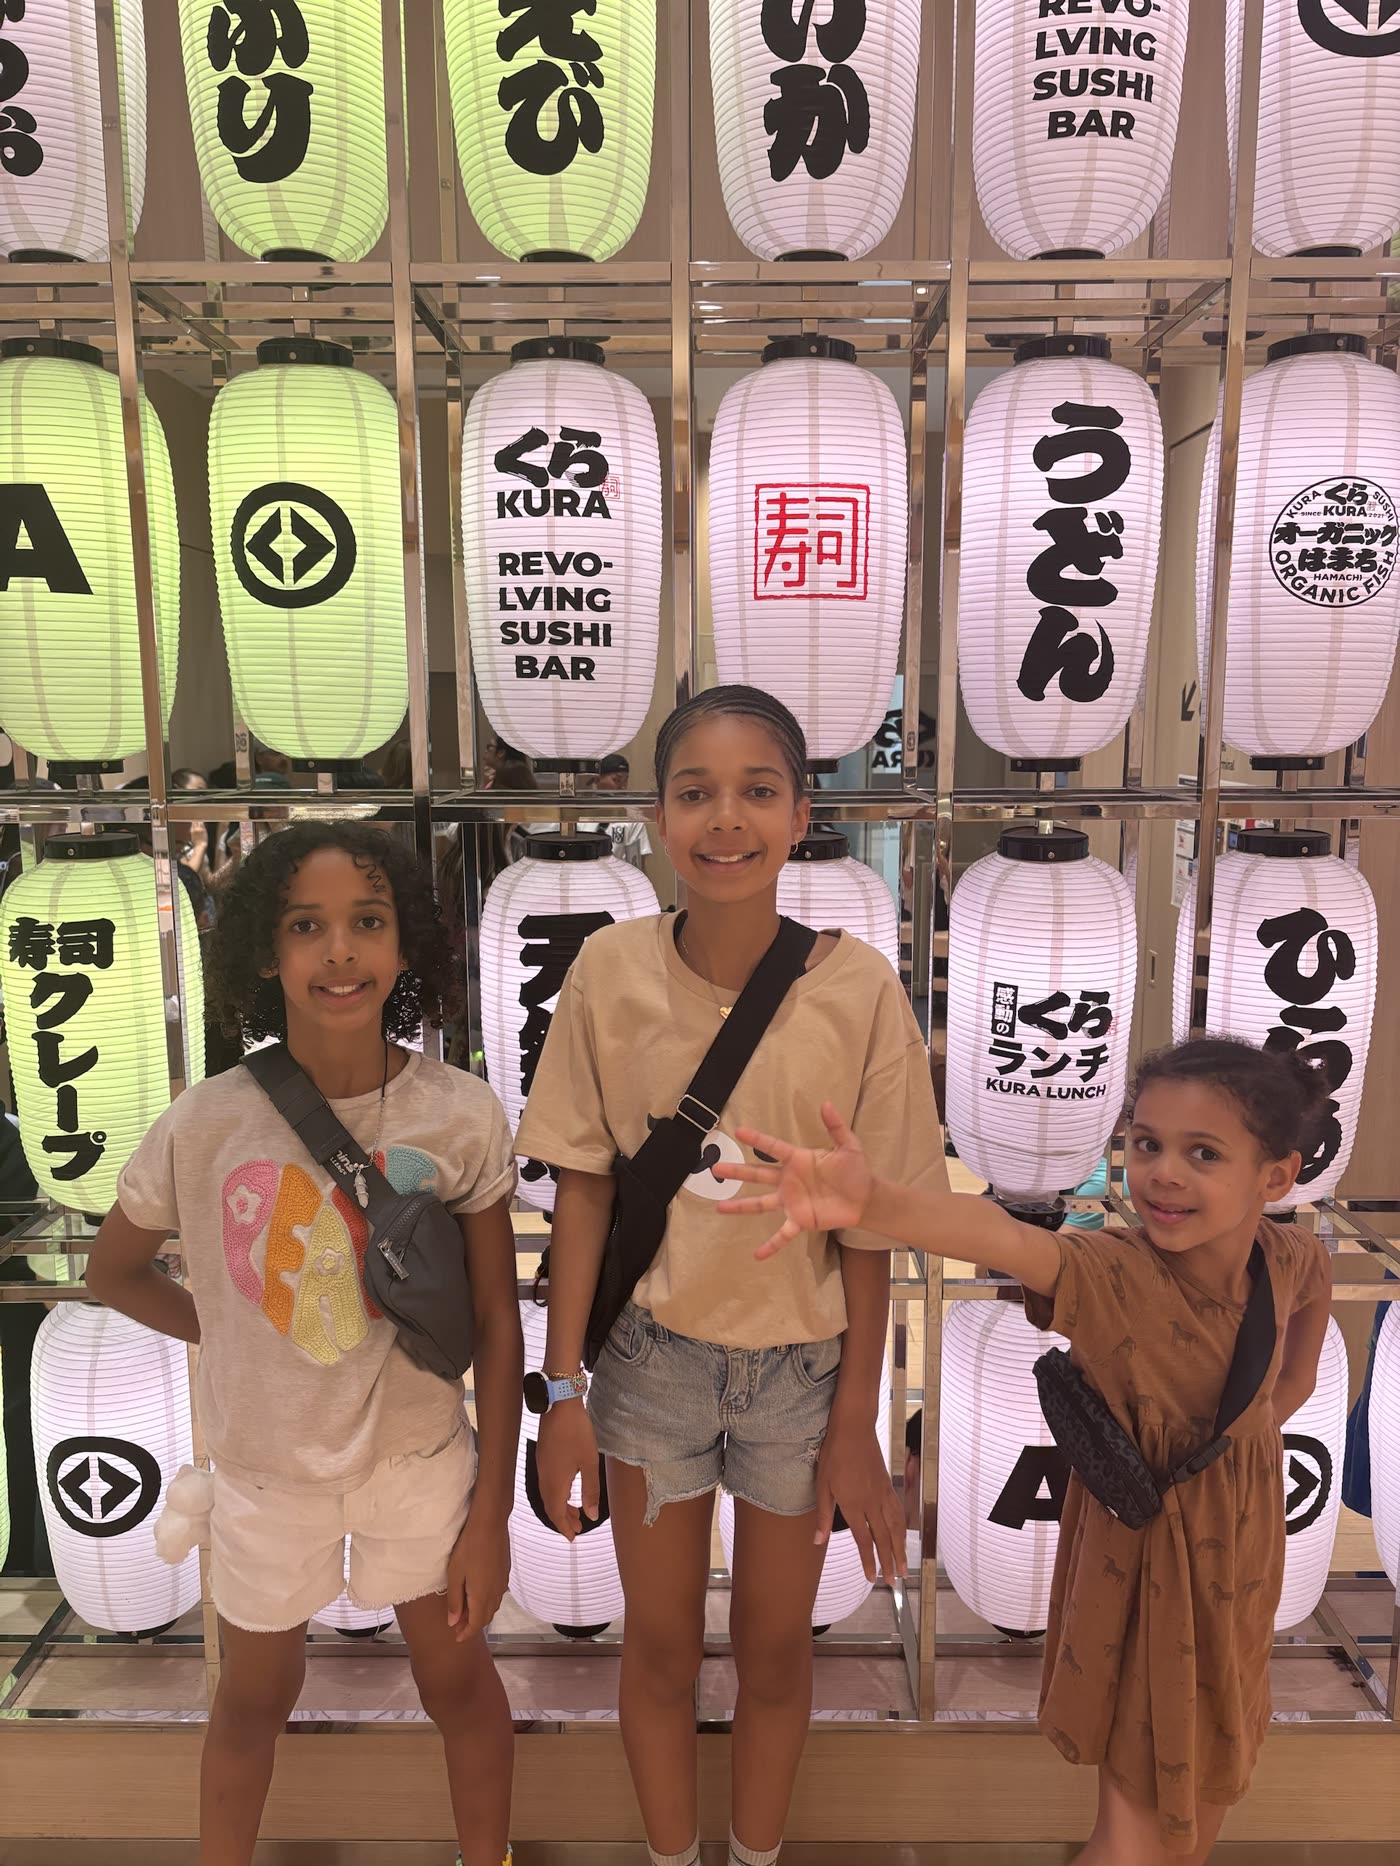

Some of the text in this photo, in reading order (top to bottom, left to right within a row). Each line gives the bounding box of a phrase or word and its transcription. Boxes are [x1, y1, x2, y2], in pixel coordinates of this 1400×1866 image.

[1035, 26, 1157, 61] LVING
[1032, 68, 1154, 103] SUSHI
[1047, 109, 1136, 139] BAR
[493, 425, 609, 488] くら
[496, 489, 612, 519] KURA
[1286, 490, 1395, 522] KURA SUSHI
[1324, 482, 1369, 505] くら
[1323, 505, 1368, 517] KURA
[0, 483, 94, 595] A
[763, 491, 861, 588] 寿司
[1273, 521, 1397, 547] オーガニック
[498, 551, 613, 577] REVO-
[1016, 401, 1131, 702] うどん
[1298, 546, 1378, 573] はまち
[1275, 550, 1395, 603] ORGANIC FISH
[1313, 573, 1363, 582] HAMACHI
[499, 586, 611, 612] LVING
[500, 621, 612, 647] SUSHI
[515, 655, 596, 681] BAR
[8, 917, 116, 970] 寿司
[1017, 990, 1113, 1041] くら
[988, 1038, 1110, 1083] ランチ
[29, 972, 107, 1181] クレープ
[986, 1077, 1107, 1099] KURA LUNCH
